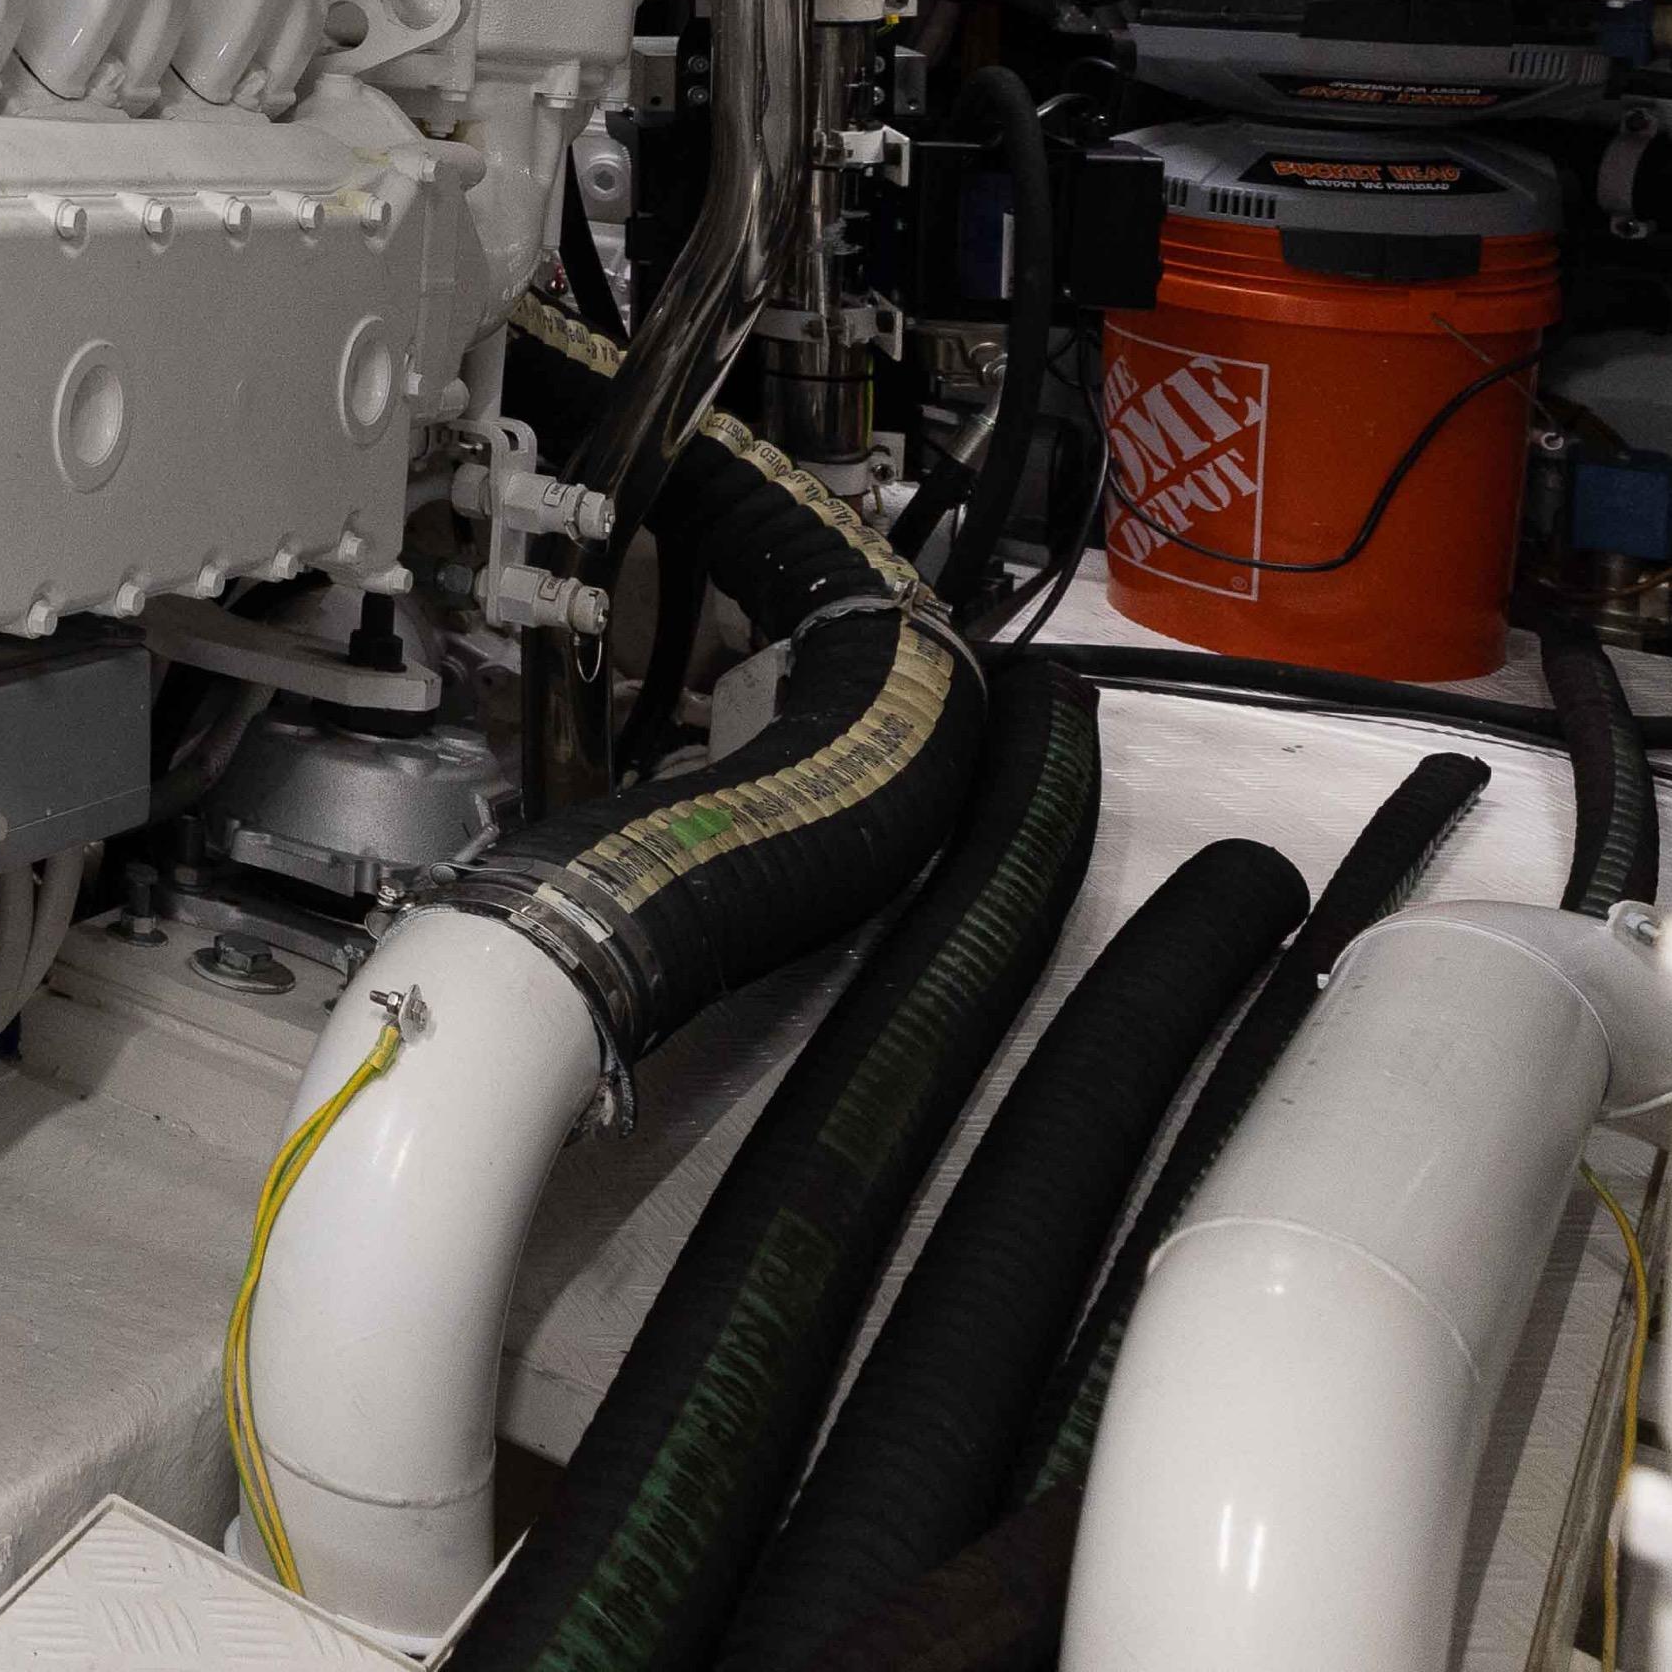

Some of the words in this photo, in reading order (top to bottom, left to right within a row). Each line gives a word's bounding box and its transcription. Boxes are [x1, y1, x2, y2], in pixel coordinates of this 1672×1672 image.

[1271, 160, 1382, 181] BUCKET
[1387, 165, 1461, 182] HEAD
[1107, 356, 1263, 528] OME
[1120, 447, 1259, 564] DEPOT
